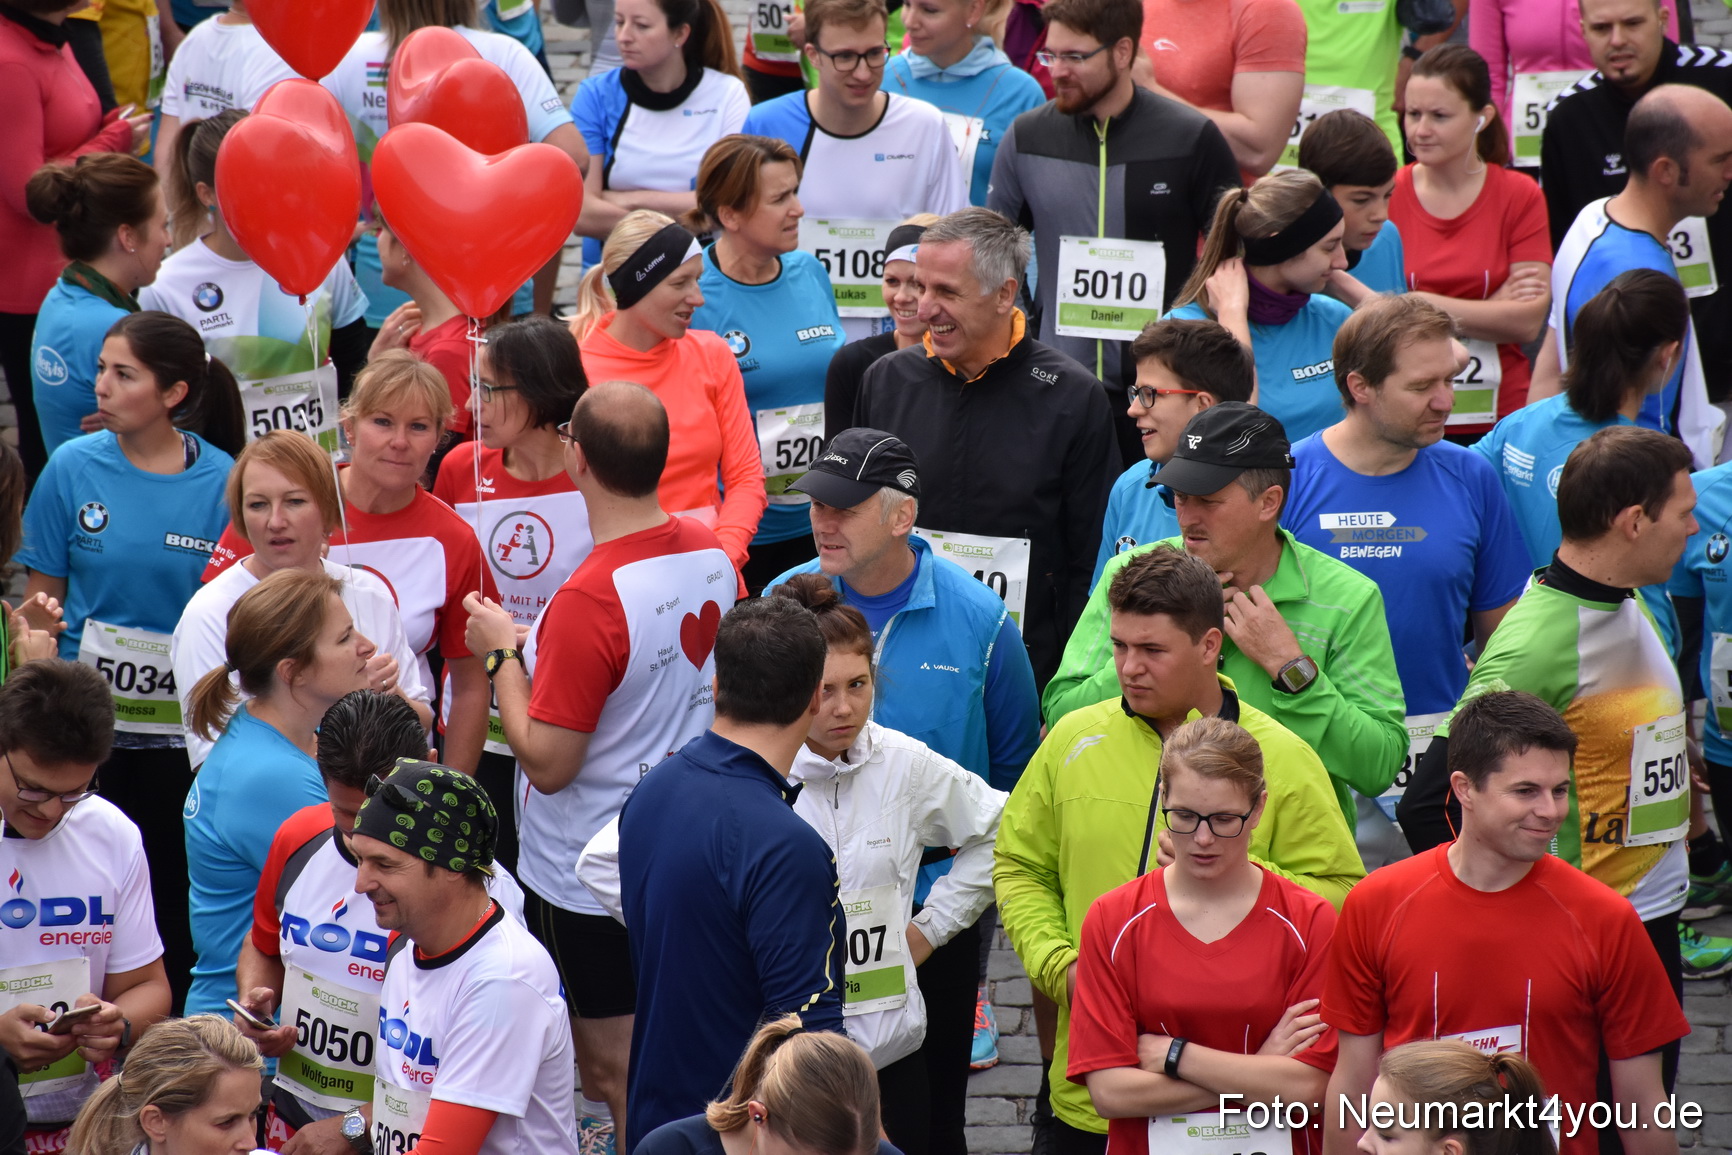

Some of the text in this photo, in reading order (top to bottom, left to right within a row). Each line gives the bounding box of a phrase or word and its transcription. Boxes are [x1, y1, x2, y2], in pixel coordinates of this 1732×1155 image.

[839, 227, 875, 238] BOCK
[1099, 249, 1134, 259] BOCK
[815, 248, 885, 279] 5108
[1072, 268, 1147, 302] 5010
[835, 288, 867, 300] Lukas
[199, 312, 233, 328] PARTL
[1090, 309, 1124, 323] Daniel
[797, 325, 836, 342] BOCK
[738, 358, 760, 369] ARTL
[1453, 356, 1484, 384] 2
[1031, 366, 1059, 382] GORE
[252, 398, 324, 439] 5035
[1338, 514, 1384, 526] HEUTE
[1352, 528, 1417, 541] MORGEN
[165, 532, 215, 553] BOCK
[953, 543, 994, 557] BOCK
[1340, 545, 1403, 559] BEWEGEN
[510, 594, 531, 606] MIT
[536, 596, 547, 608] H
[666, 596, 681, 611] Sport
[128, 638, 169, 654] BOCK
[657, 645, 674, 658] Haus
[96, 656, 178, 695] 5034
[933, 664, 960, 673] VAUDE
[114, 702, 156, 716] anessa
[1408, 727, 1434, 737] OCK
[843, 901, 871, 913] OCK
[845, 924, 887, 967] 07
[348, 961, 385, 982] ene
[10, 974, 53, 991] BOCK
[320, 990, 359, 1013] BOCK
[295, 1007, 374, 1067] 5050
[300, 1061, 354, 1093] Wolfgang
[402, 1060, 438, 1085] energ
[1202, 1124, 1250, 1137] BOCK
